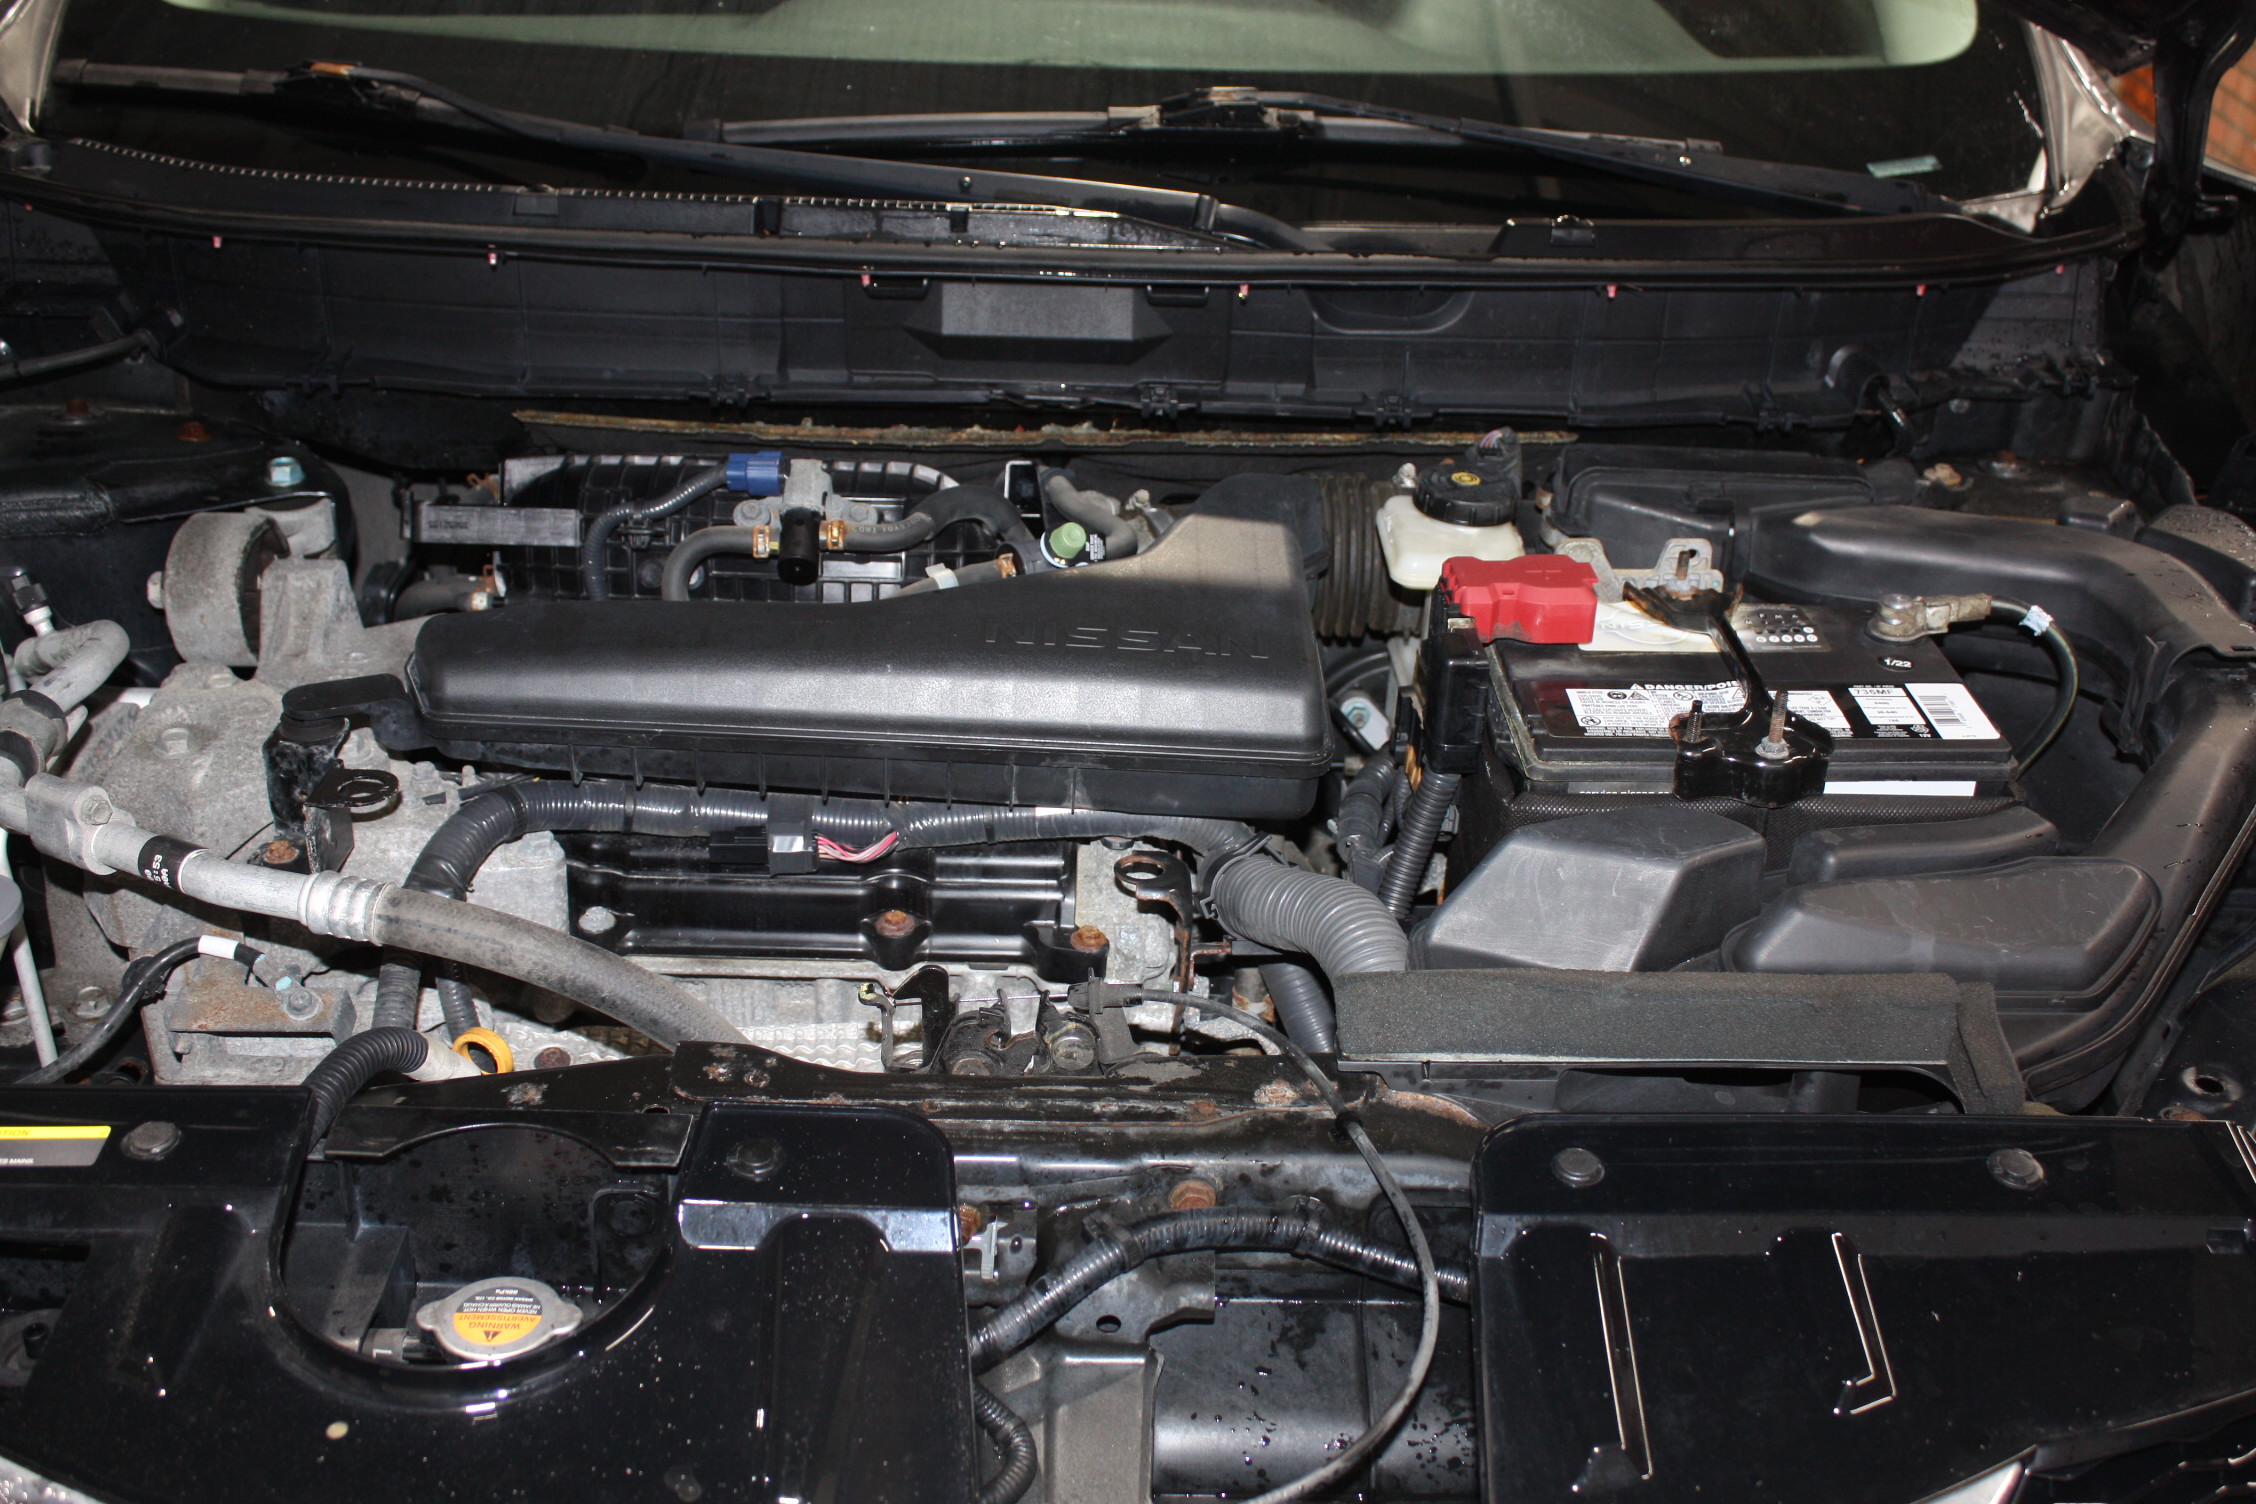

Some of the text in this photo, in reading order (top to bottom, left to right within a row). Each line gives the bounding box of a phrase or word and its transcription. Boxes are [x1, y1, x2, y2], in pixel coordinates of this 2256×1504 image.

[985, 621, 1270, 659] NISSAN
[1884, 657, 1912, 668] 1/22
[458, 1314, 537, 1322] AVERTISSEMENT
[468, 1321, 521, 1330] WARNING
